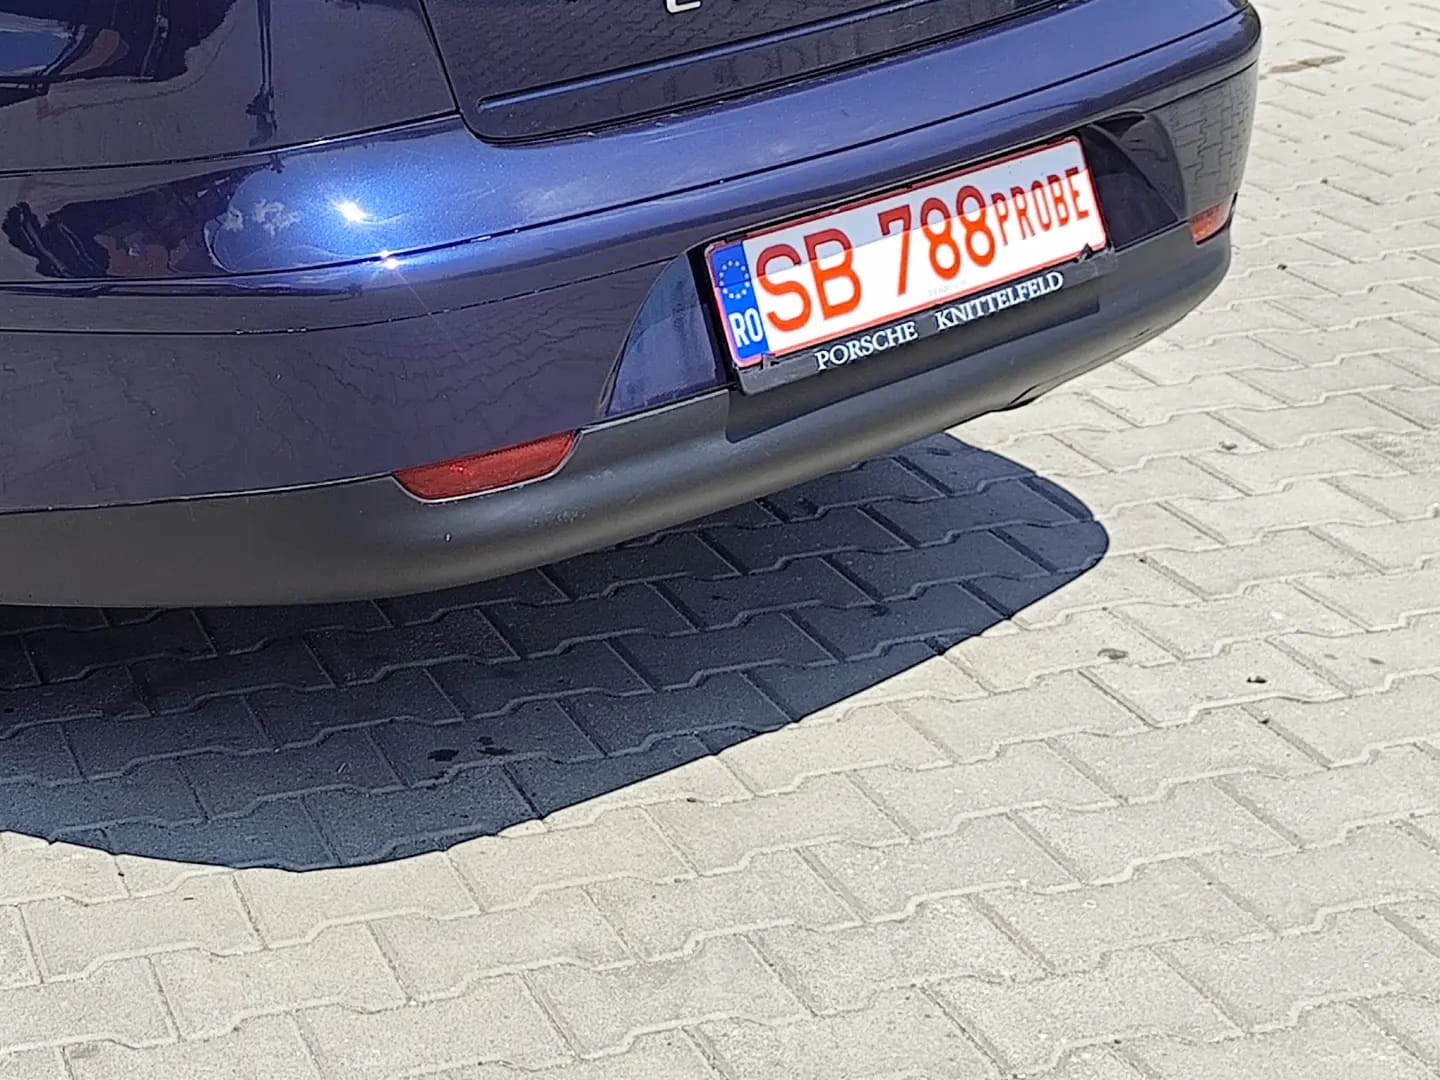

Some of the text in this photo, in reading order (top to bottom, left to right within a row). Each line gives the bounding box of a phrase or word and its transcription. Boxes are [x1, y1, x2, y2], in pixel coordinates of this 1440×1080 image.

[755, 167, 1090, 333] SB 788 PROBE
[729, 310, 763, 350] RO
[814, 271, 1064, 371] PORSCHE KNITTELFELD
